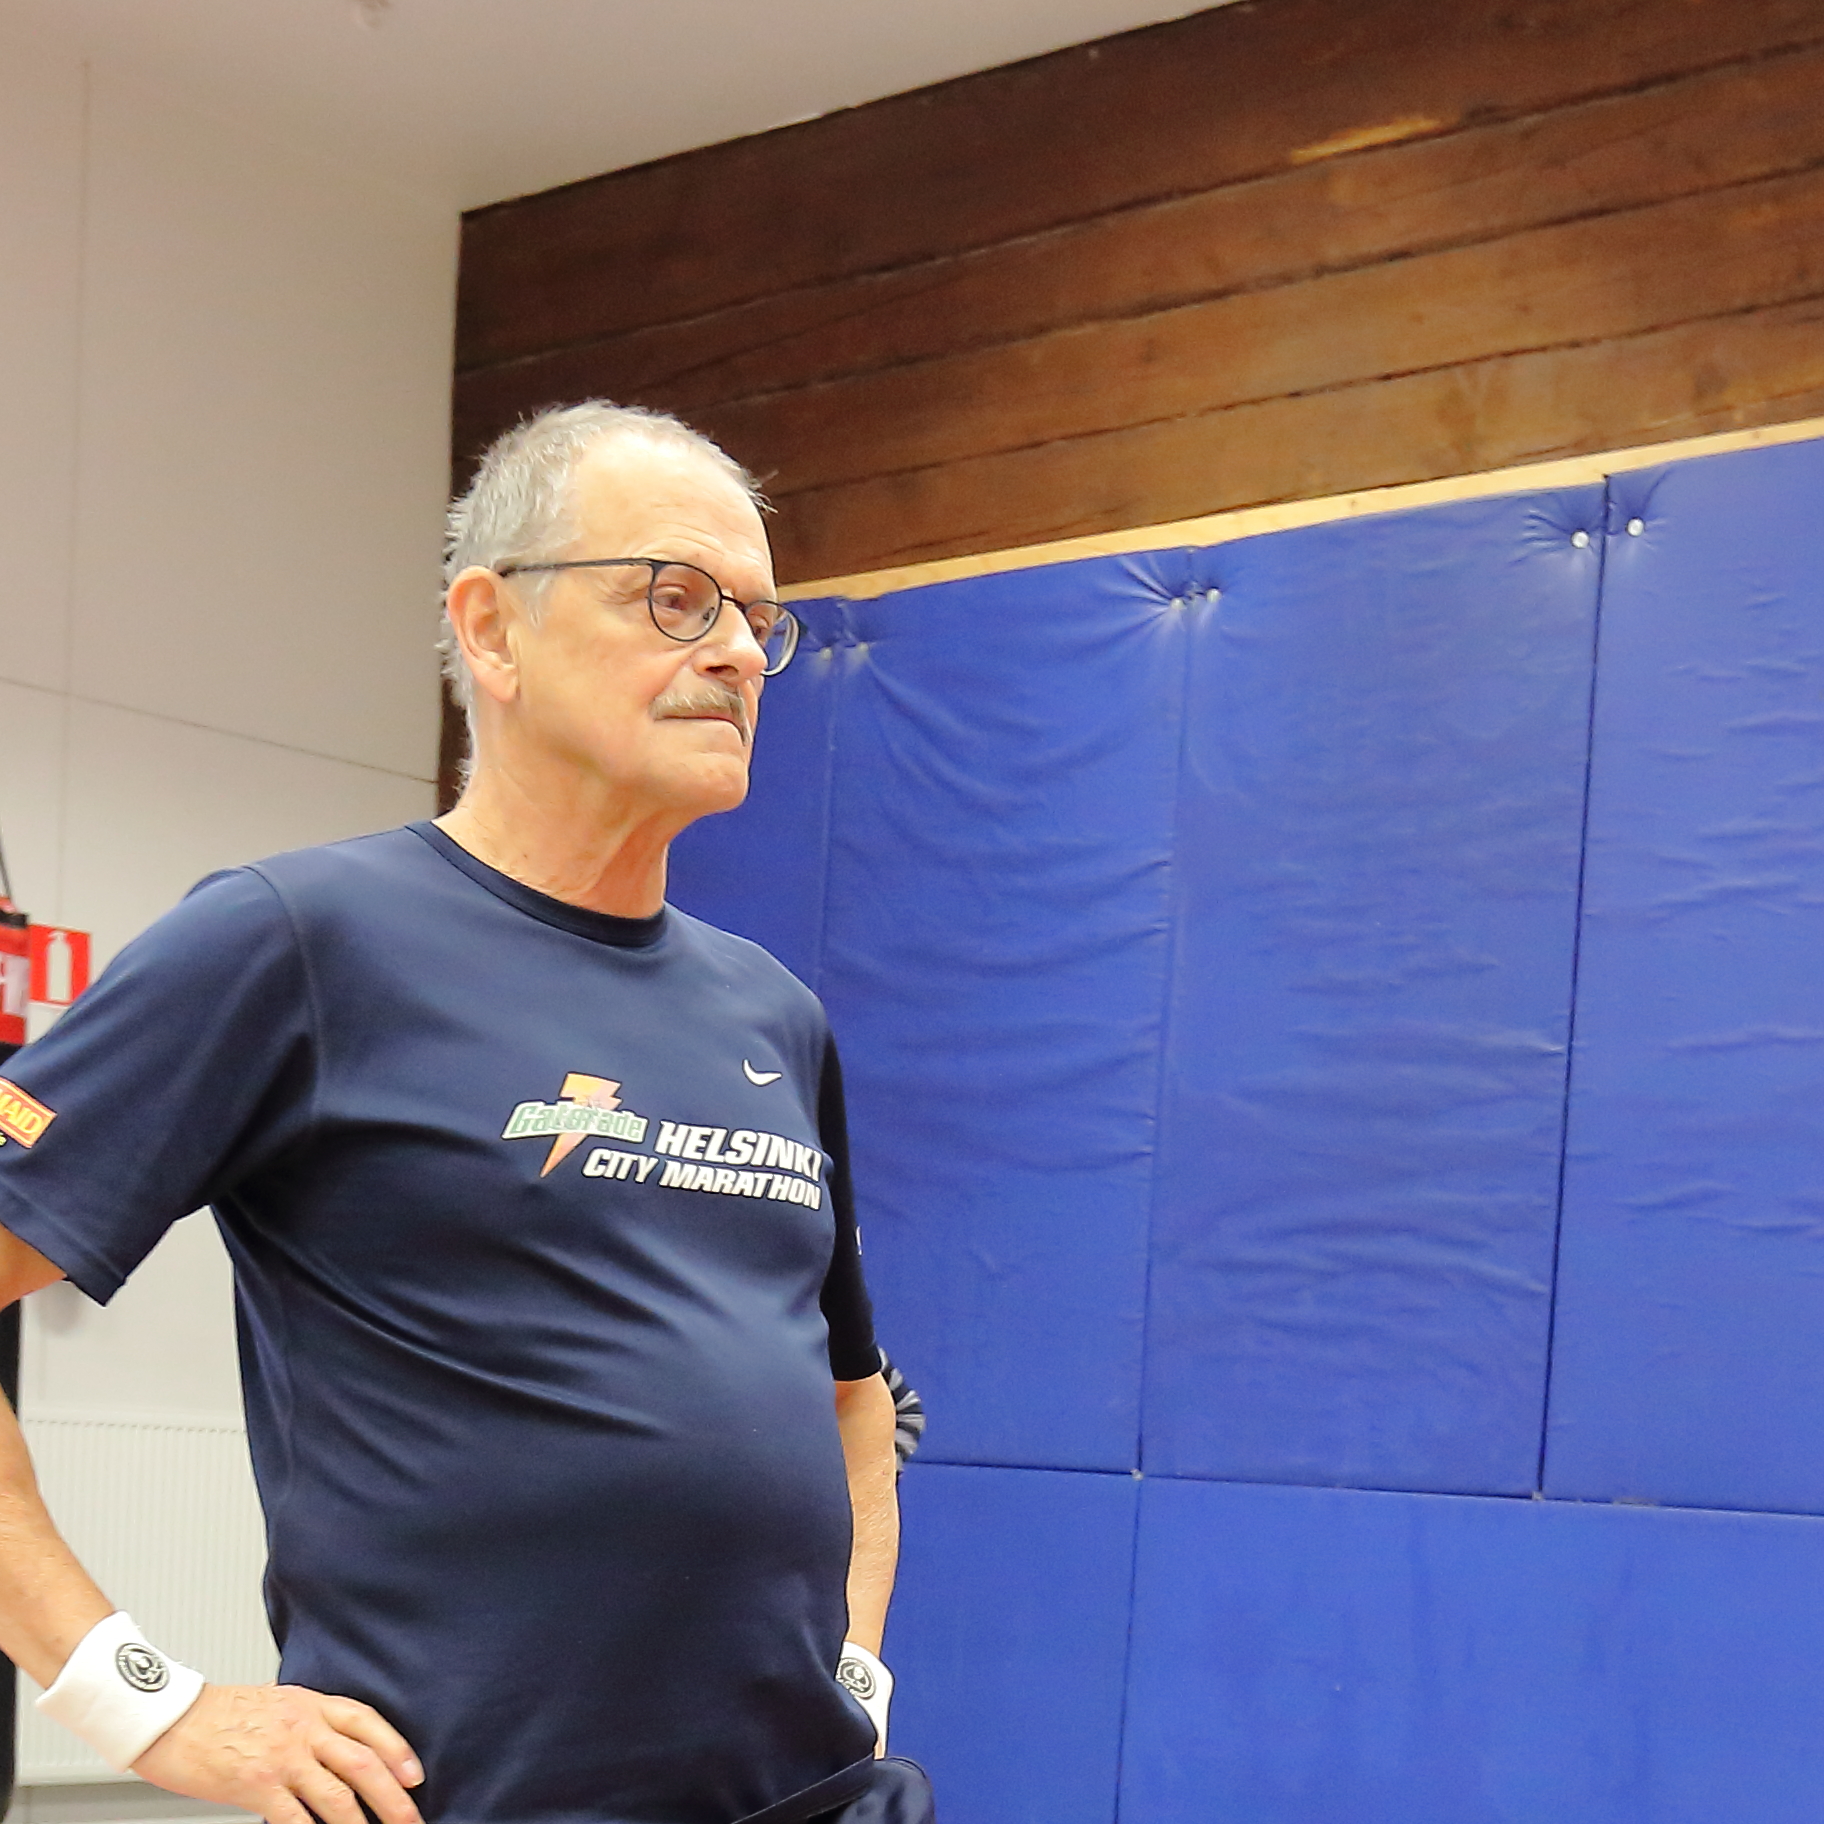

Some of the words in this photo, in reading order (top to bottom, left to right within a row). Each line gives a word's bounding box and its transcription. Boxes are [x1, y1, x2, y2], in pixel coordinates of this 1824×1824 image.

[505, 1101, 646, 1141] Gatorade
[654, 1120, 823, 1182] HELSINKI
[582, 1147, 658, 1183] CITY
[659, 1159, 822, 1210] MARATHON
